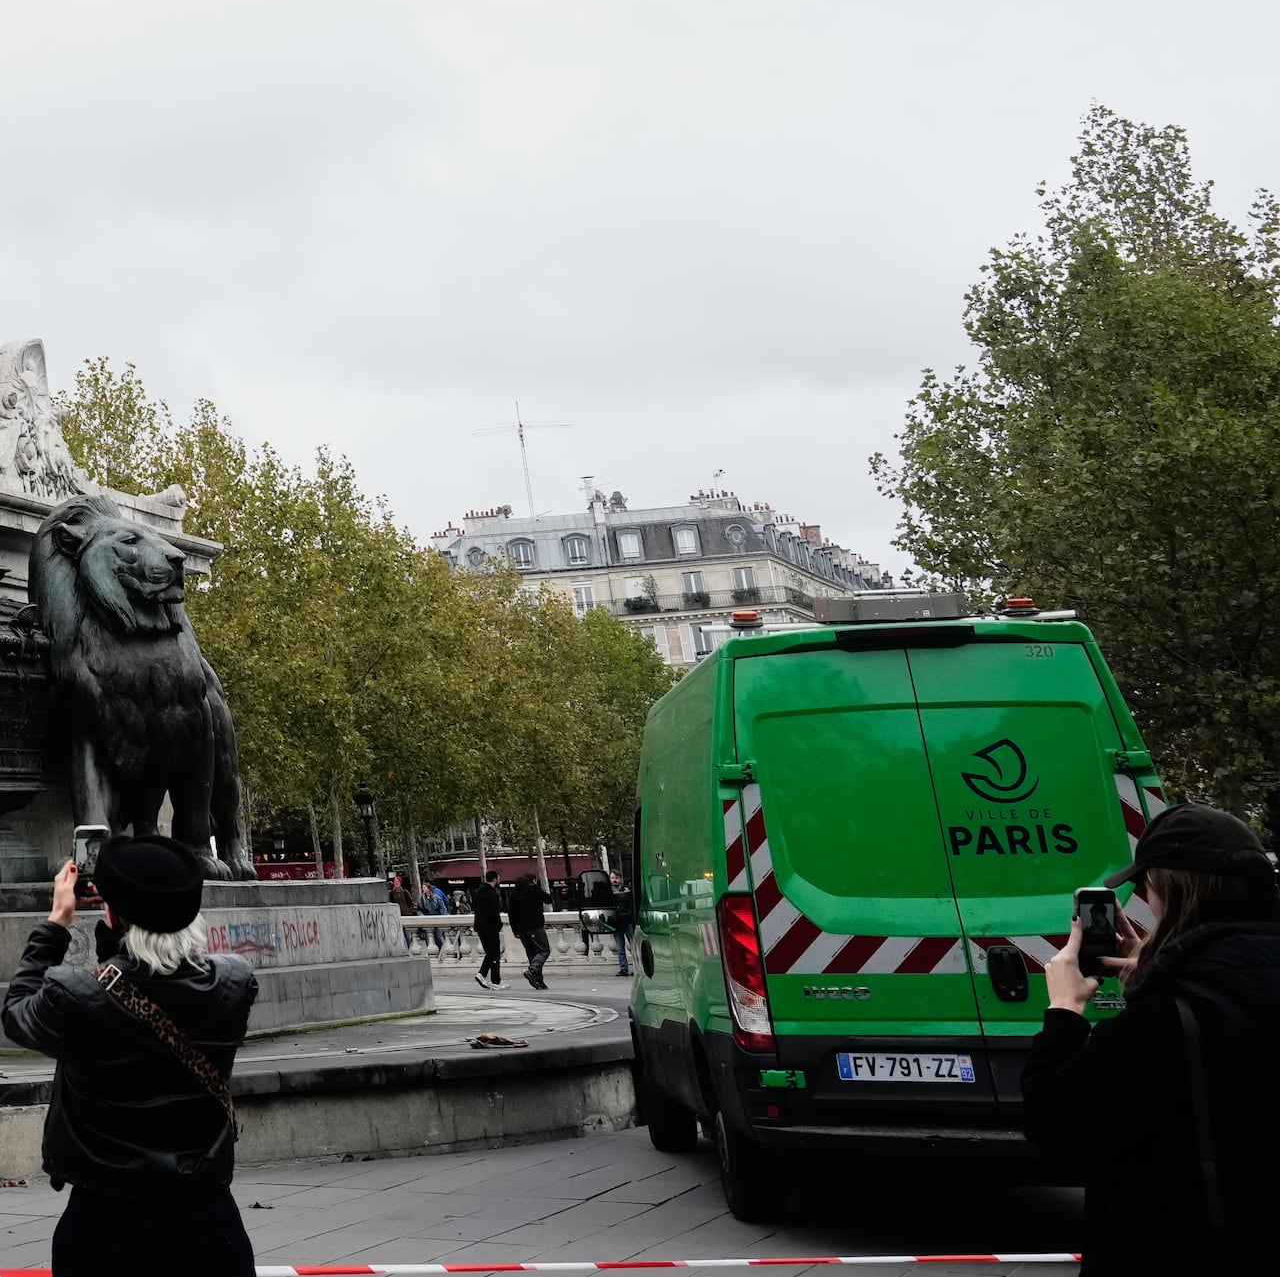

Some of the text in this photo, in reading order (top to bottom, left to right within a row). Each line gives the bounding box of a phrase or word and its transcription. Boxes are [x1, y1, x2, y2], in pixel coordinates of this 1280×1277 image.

[1024, 645, 1054, 658] 320
[965, 808, 1052, 820] VILLE DE
[948, 823, 1078, 855] PARIS
[803, 985, 872, 1001] IVECO
[852, 1056, 960, 1078] FV-791-ZZ
[961, 1068, 974, 1080] 92
